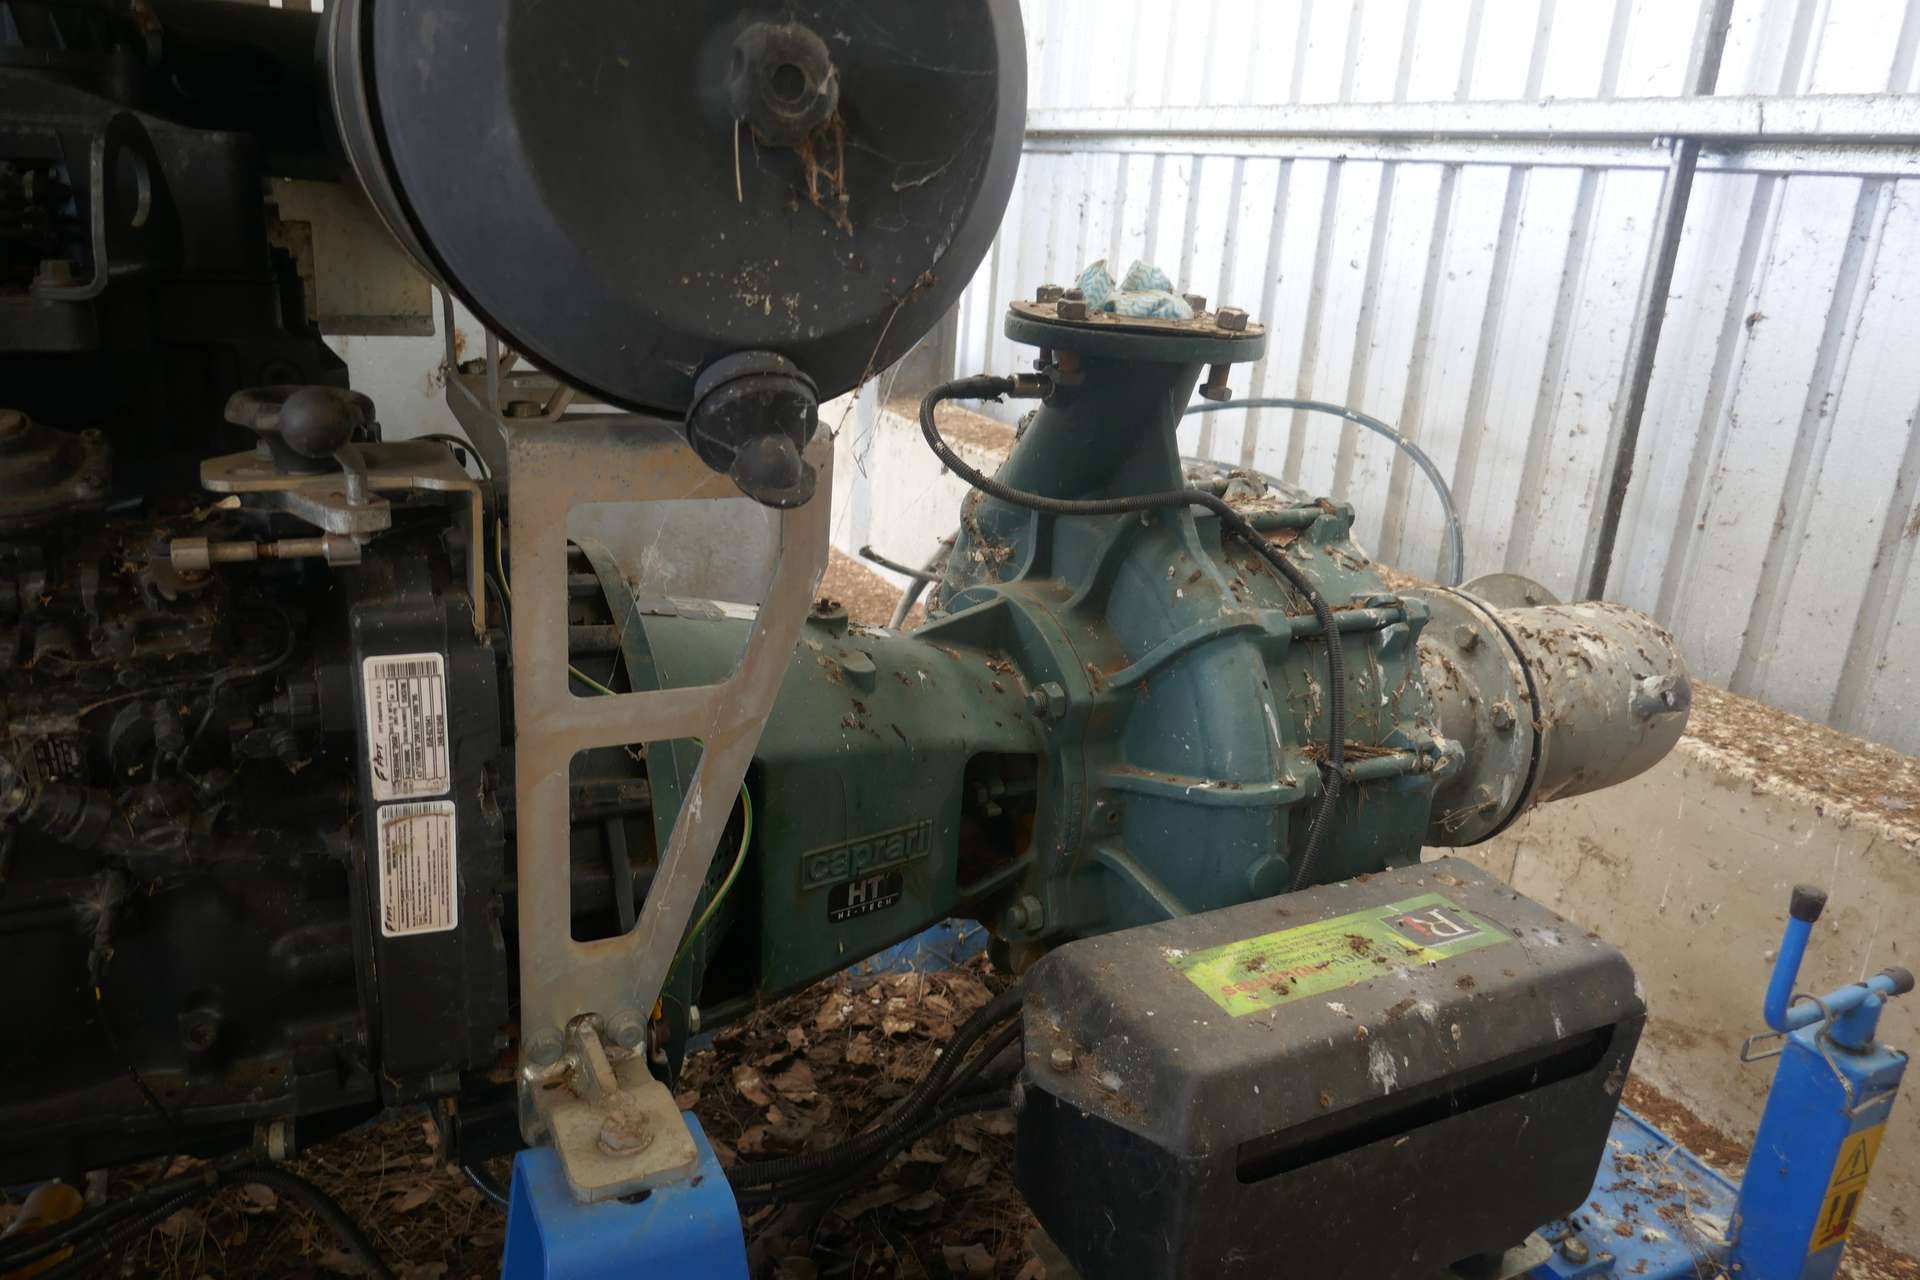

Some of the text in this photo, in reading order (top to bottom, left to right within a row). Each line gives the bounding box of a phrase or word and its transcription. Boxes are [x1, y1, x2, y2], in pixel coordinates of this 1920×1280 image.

[808, 827, 927, 880] caprari
[848, 875, 880, 906] HT
[837, 897, 893, 920] HI-TECH
